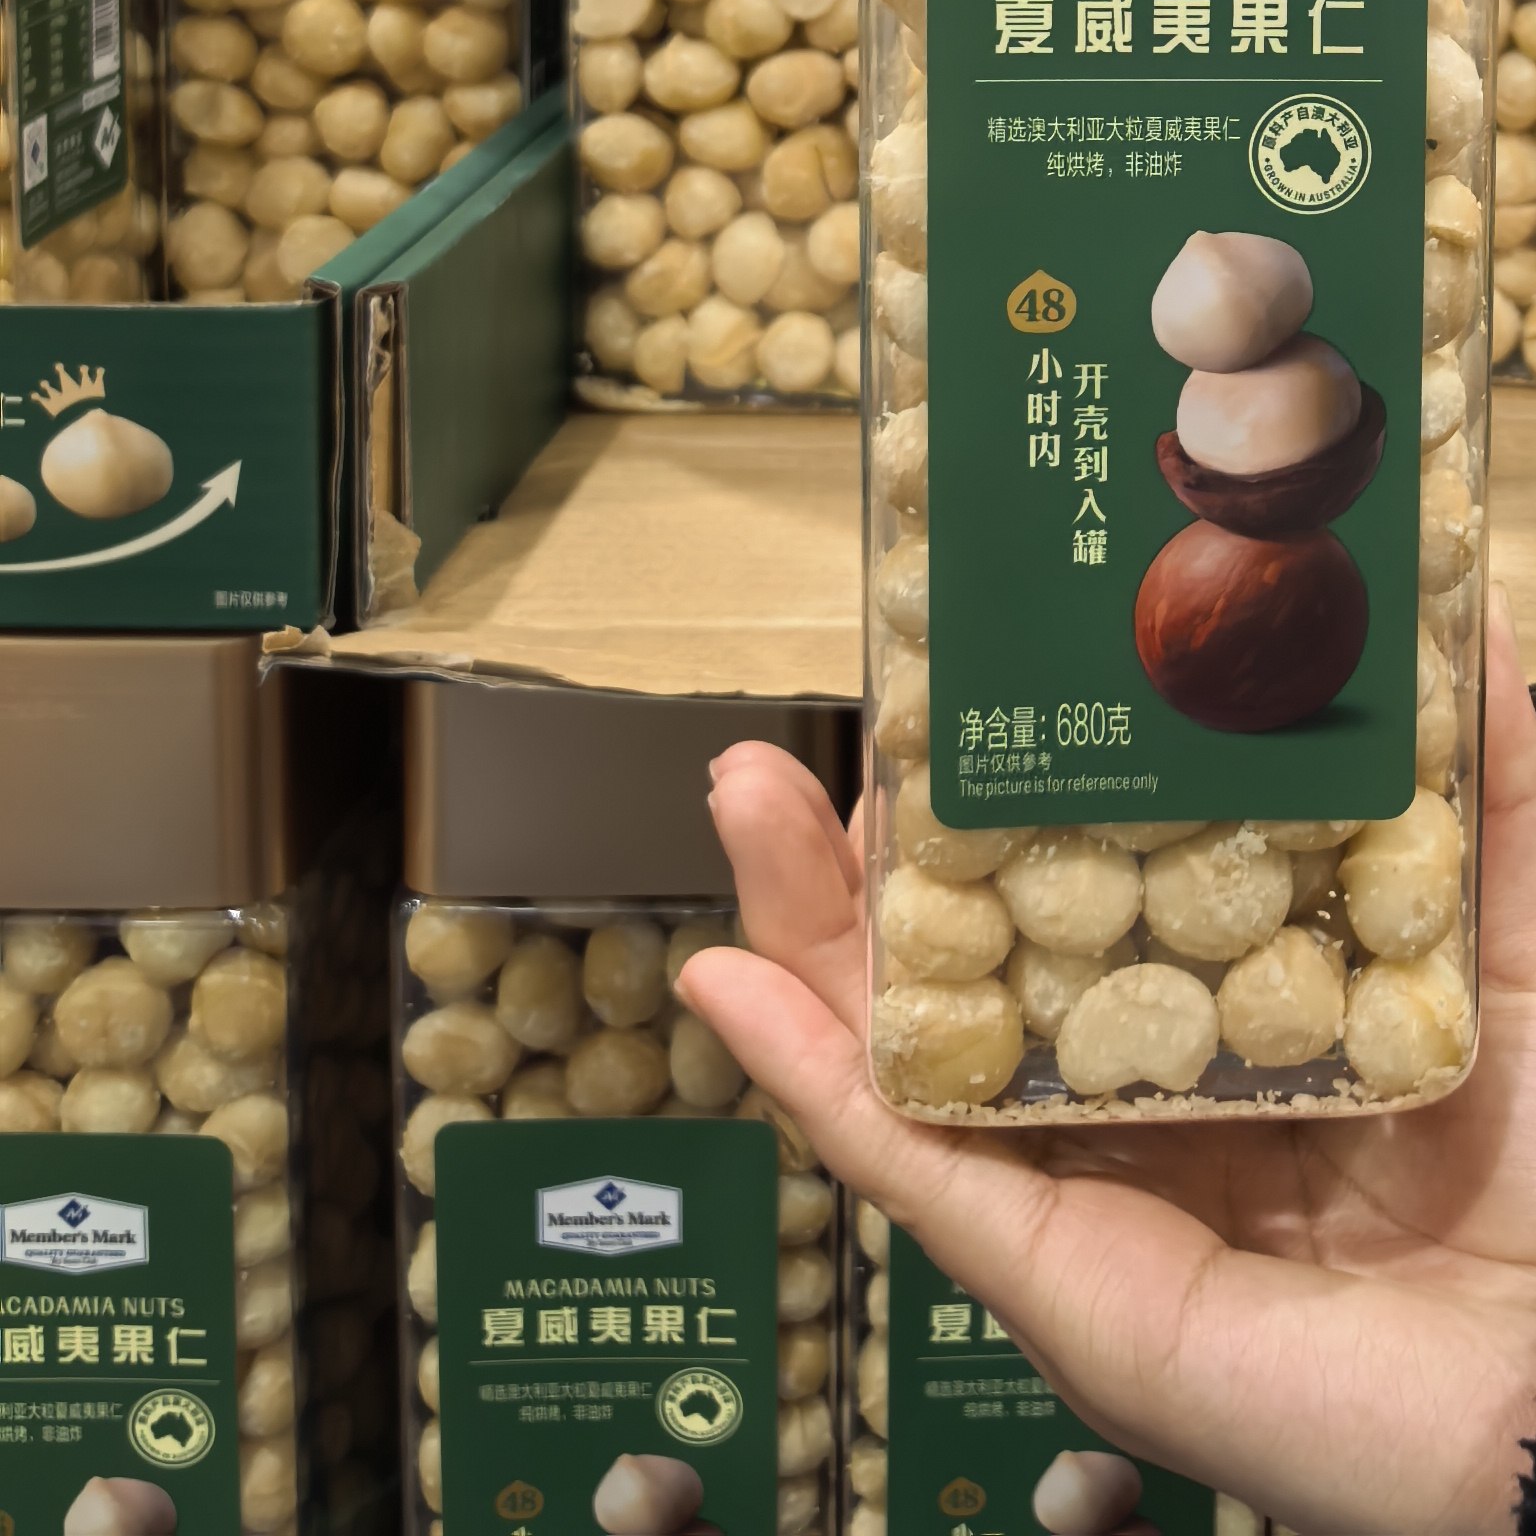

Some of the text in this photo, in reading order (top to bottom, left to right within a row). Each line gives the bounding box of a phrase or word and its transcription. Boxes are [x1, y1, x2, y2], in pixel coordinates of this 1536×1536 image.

[986, 116, 1241, 143] 精选澳大利亚大粒夏威夷果仁
[1046, 151, 1183, 178] 纯烘烤，非油炸
[1263, 163, 1359, 203] GROWN IN AUSTRALIA
[1014, 288, 1067, 323] 48
[1025, 347, 1063, 468] 小时内
[1072, 362, 1109, 566] 开壳到入罐
[959, 772, 1159, 801] The picture is for reference only
[547, 1211, 672, 1228] Member's Mark
[10, 1228, 137, 1244] Member's Mark
[504, 1278, 716, 1299] MACADAMIA NUTS
[0, 1295, 186, 1317] CADAMIA NUTS
[481, 1305, 738, 1347] 夏威夷果仁
[0, 1324, 208, 1366] 威夷果仁
